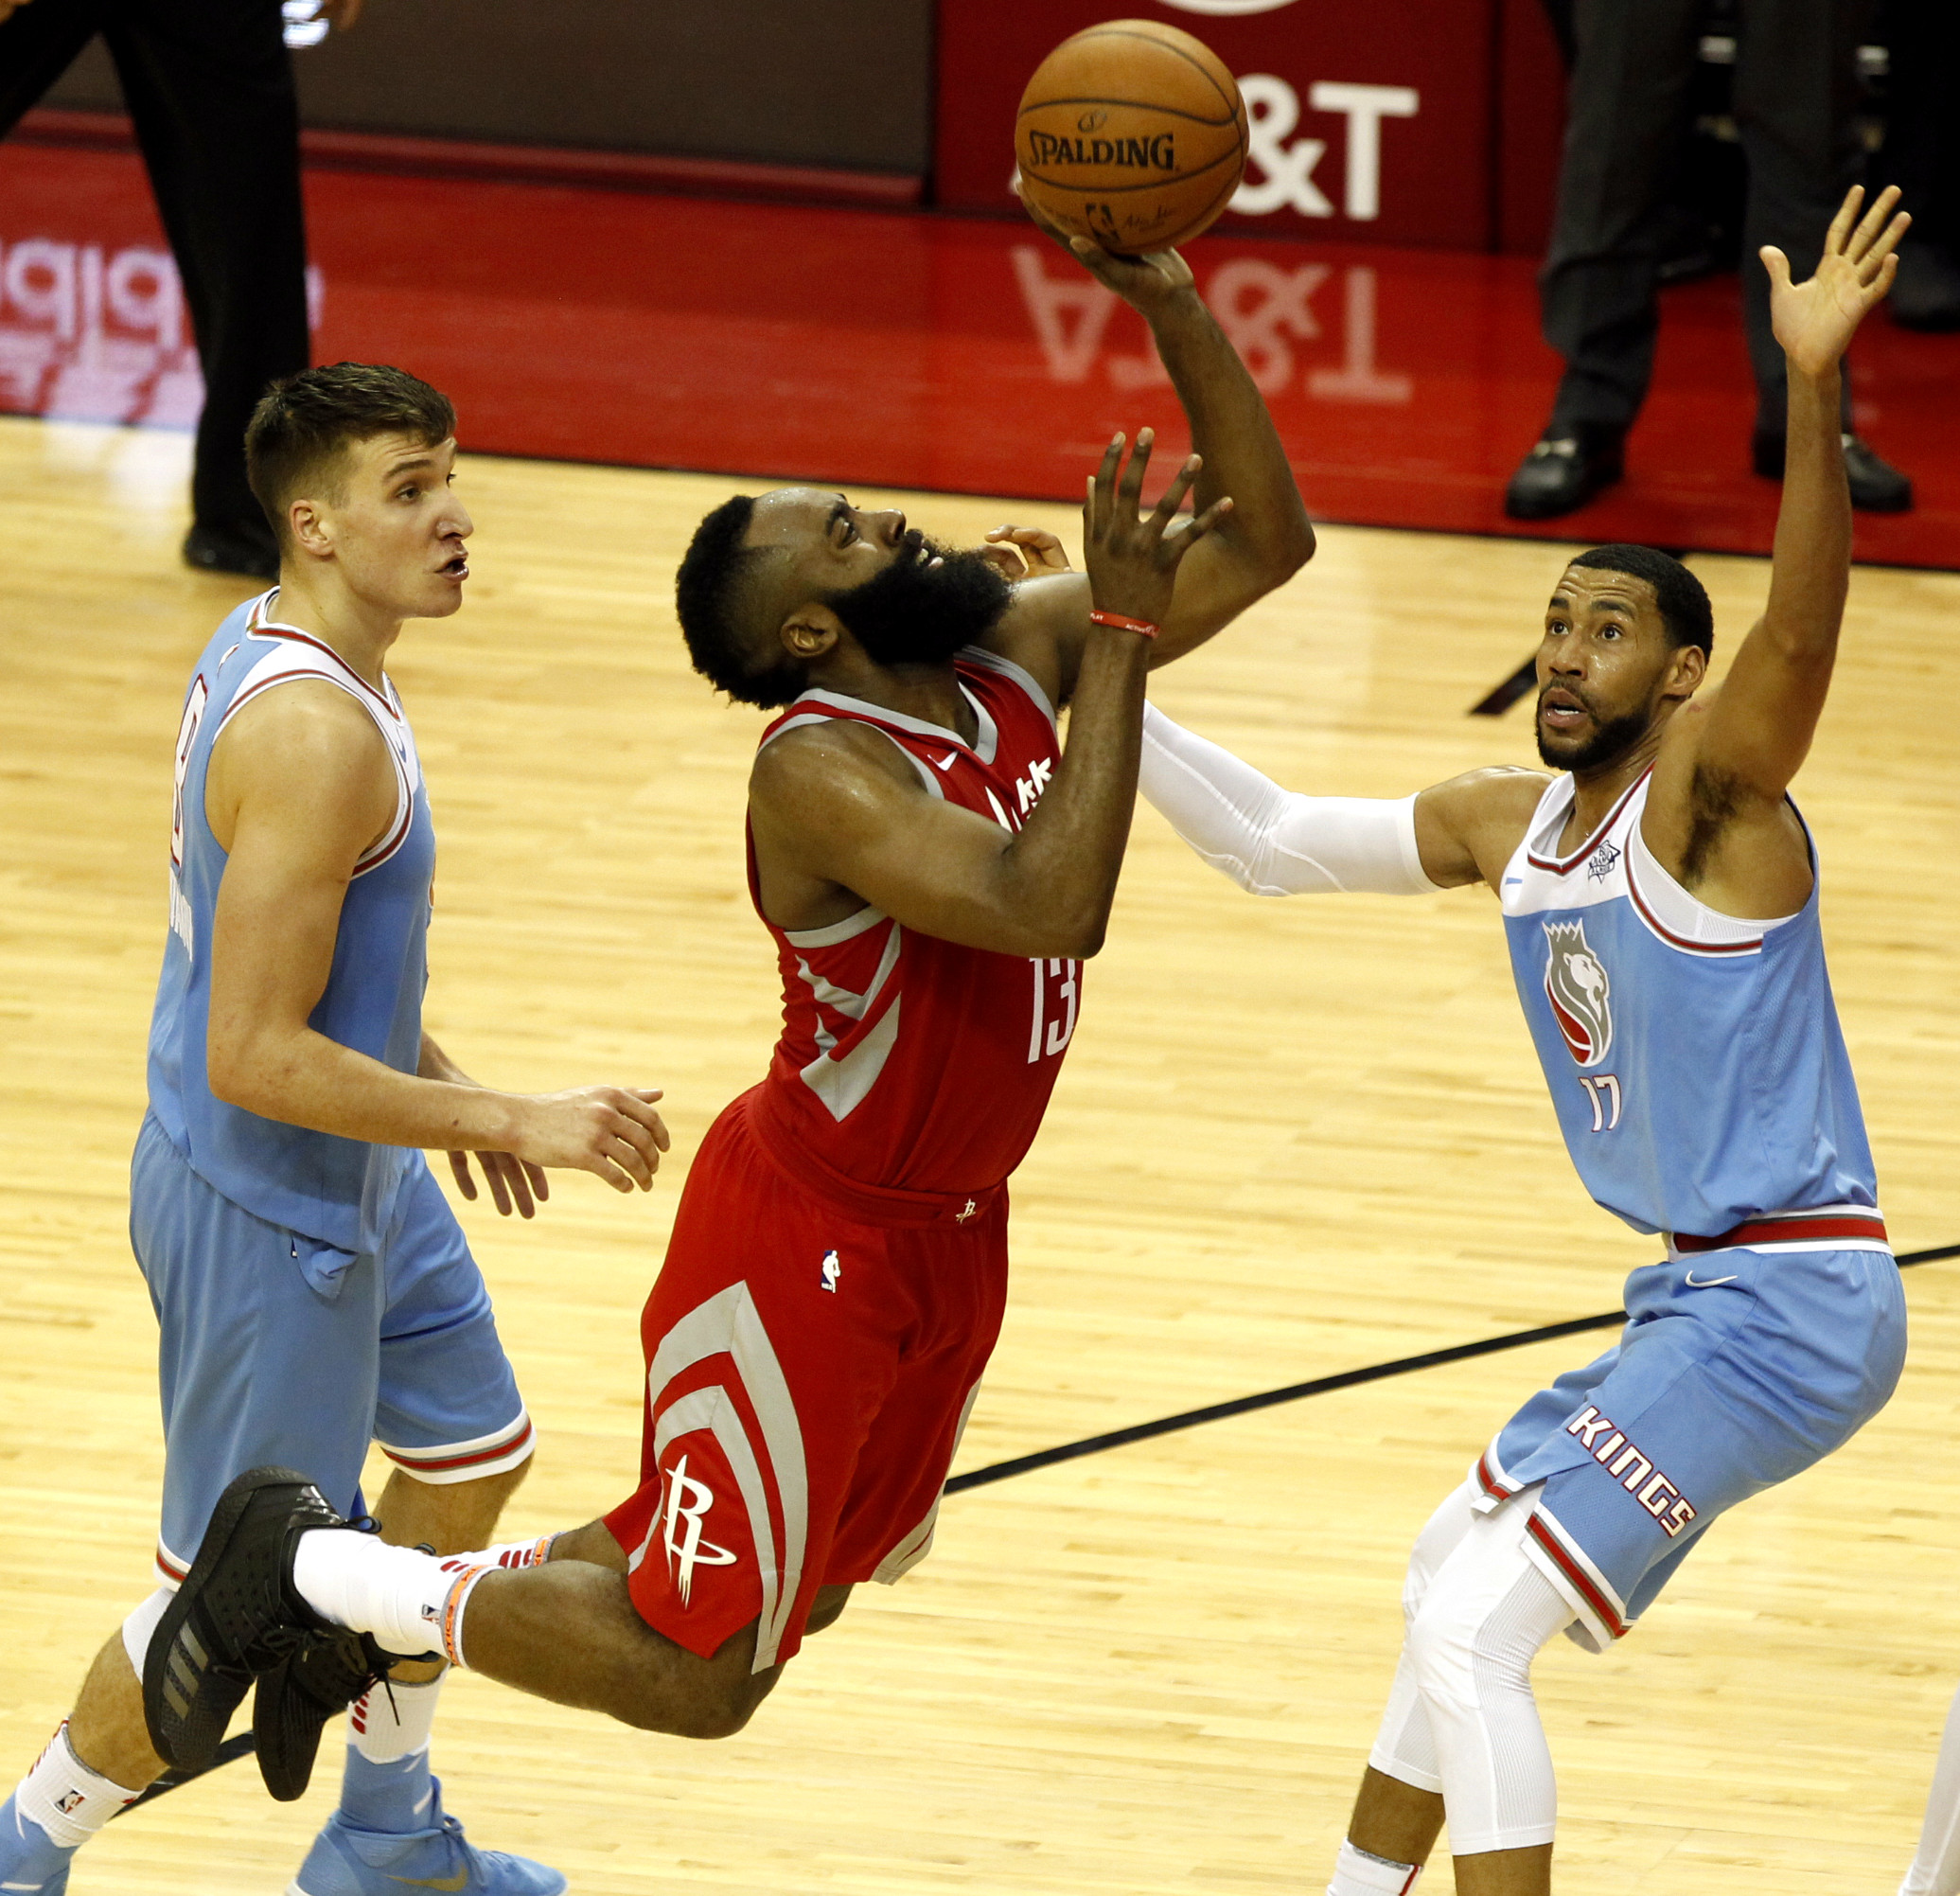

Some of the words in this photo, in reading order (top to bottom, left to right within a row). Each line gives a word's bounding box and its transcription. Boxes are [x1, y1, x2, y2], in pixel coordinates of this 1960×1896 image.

[1029, 131, 1175, 172] SPALDING
[1027, 958, 1077, 1065] 13
[1579, 1072, 1623, 1134] 17
[1566, 1405, 1698, 1539] KINGS
